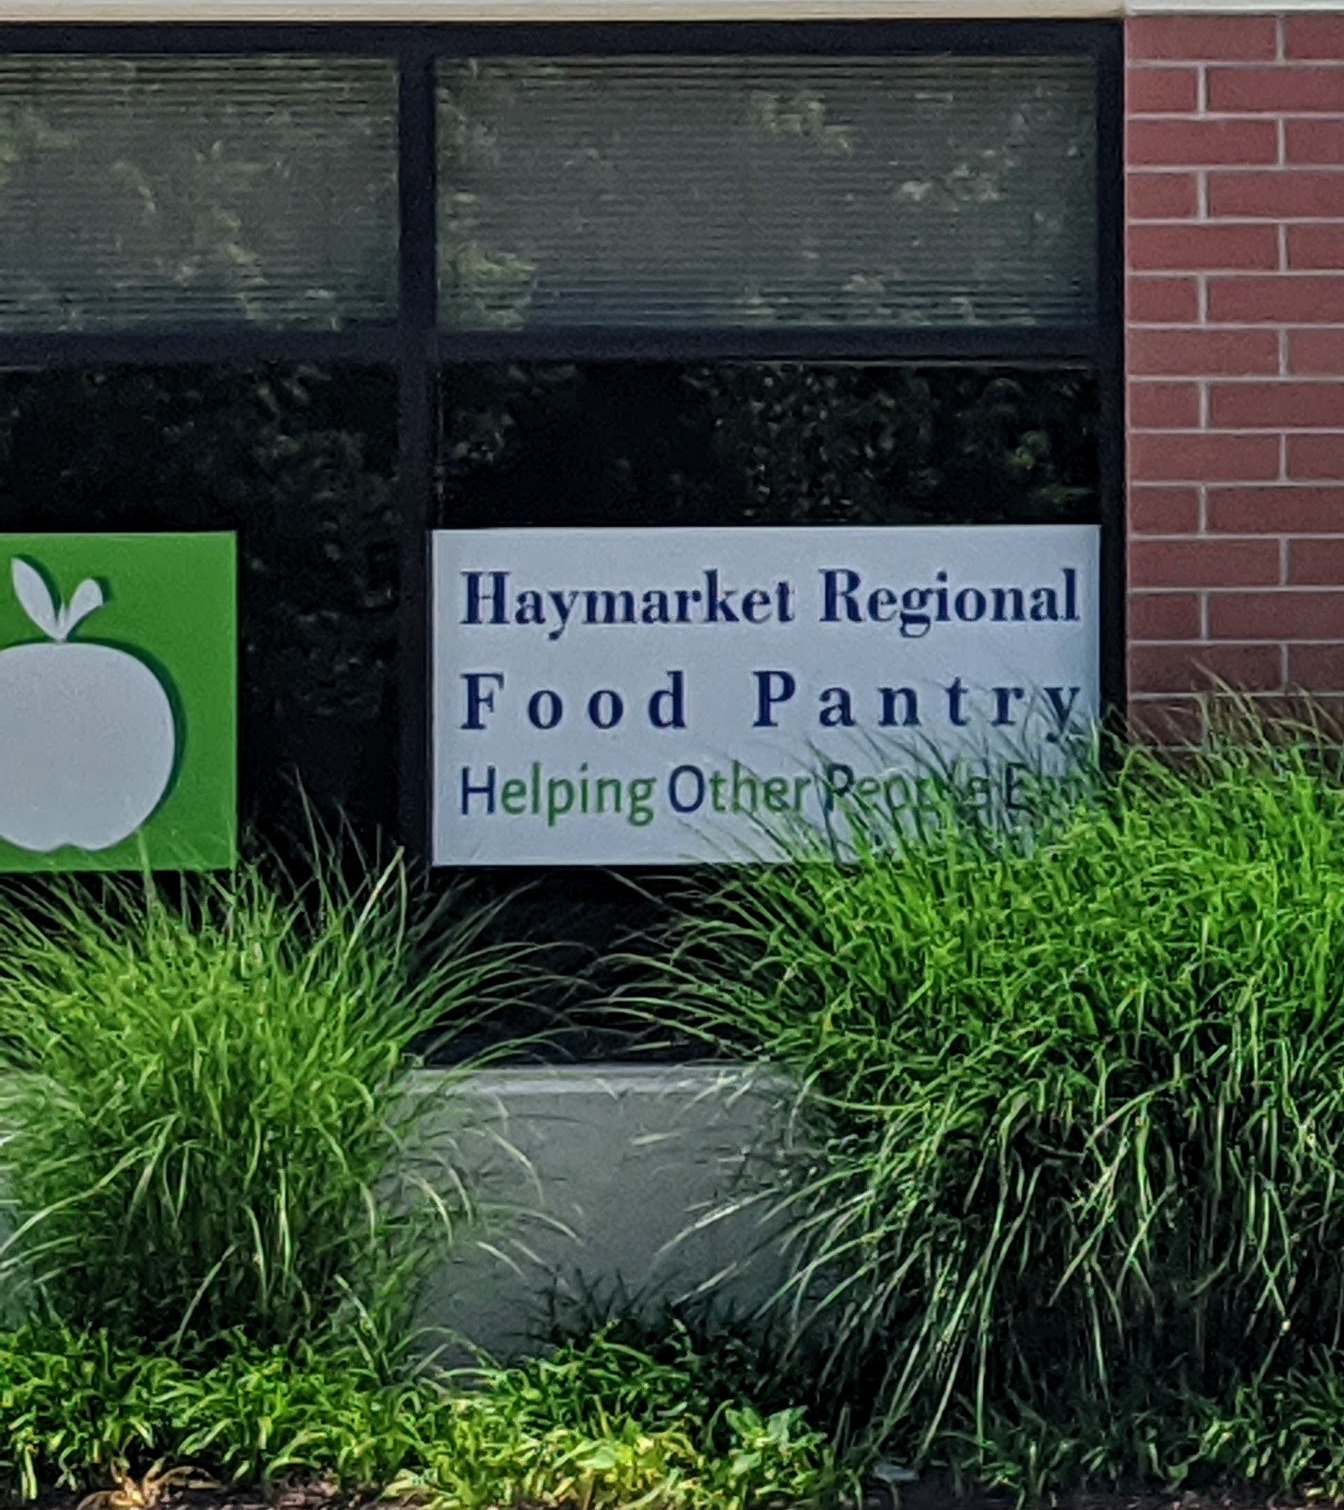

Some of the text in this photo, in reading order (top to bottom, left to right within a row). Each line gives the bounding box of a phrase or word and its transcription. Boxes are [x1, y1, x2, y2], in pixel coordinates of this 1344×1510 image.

[460, 568, 1081, 640] Haymarket Regional
[460, 670, 1081, 742] Food Pantry
[461, 762, 657, 827] Helping
[667, 761, 810, 816] Other
[826, 760, 991, 828] Peoe
